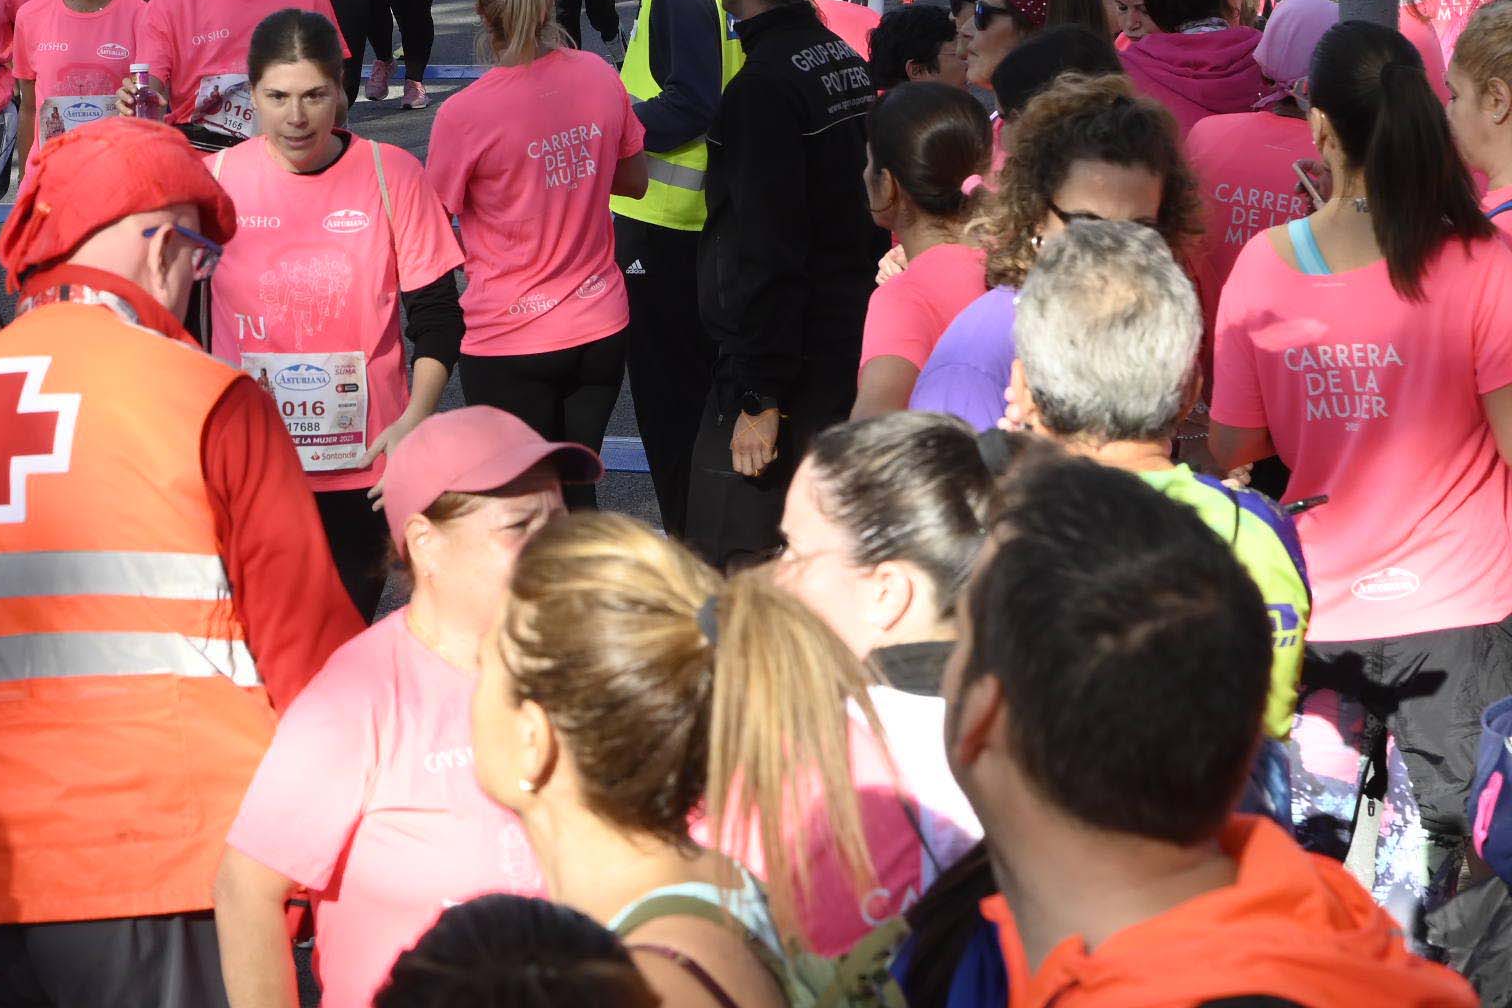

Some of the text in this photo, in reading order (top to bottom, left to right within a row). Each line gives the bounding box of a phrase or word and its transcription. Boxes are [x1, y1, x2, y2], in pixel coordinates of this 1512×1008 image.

[191, 28, 230, 46] OYSHO
[66, 107, 101, 118] ASTURIANA
[224, 99, 254, 121] 016
[527, 122, 603, 159] CARRERA
[544, 143, 591, 172] DE LA
[1214, 182, 1307, 217] CARRER
[236, 215, 281, 229] YSHO
[326, 216, 369, 228] ASTURIANA
[1232, 206, 1259, 229] DE
[508, 298, 558, 315] OYSHO
[234, 313, 267, 340] TU
[1284, 342, 1404, 372] CARRERA
[279, 372, 328, 385] ASTURIANA
[334, 367, 357, 376] SUMA
[1305, 369, 1380, 396] DE LA
[282, 400, 326, 418] 016
[1306, 395, 1389, 422] MUJER
[301, 435, 312, 444] LA
[313, 434, 337, 444] MUJER
